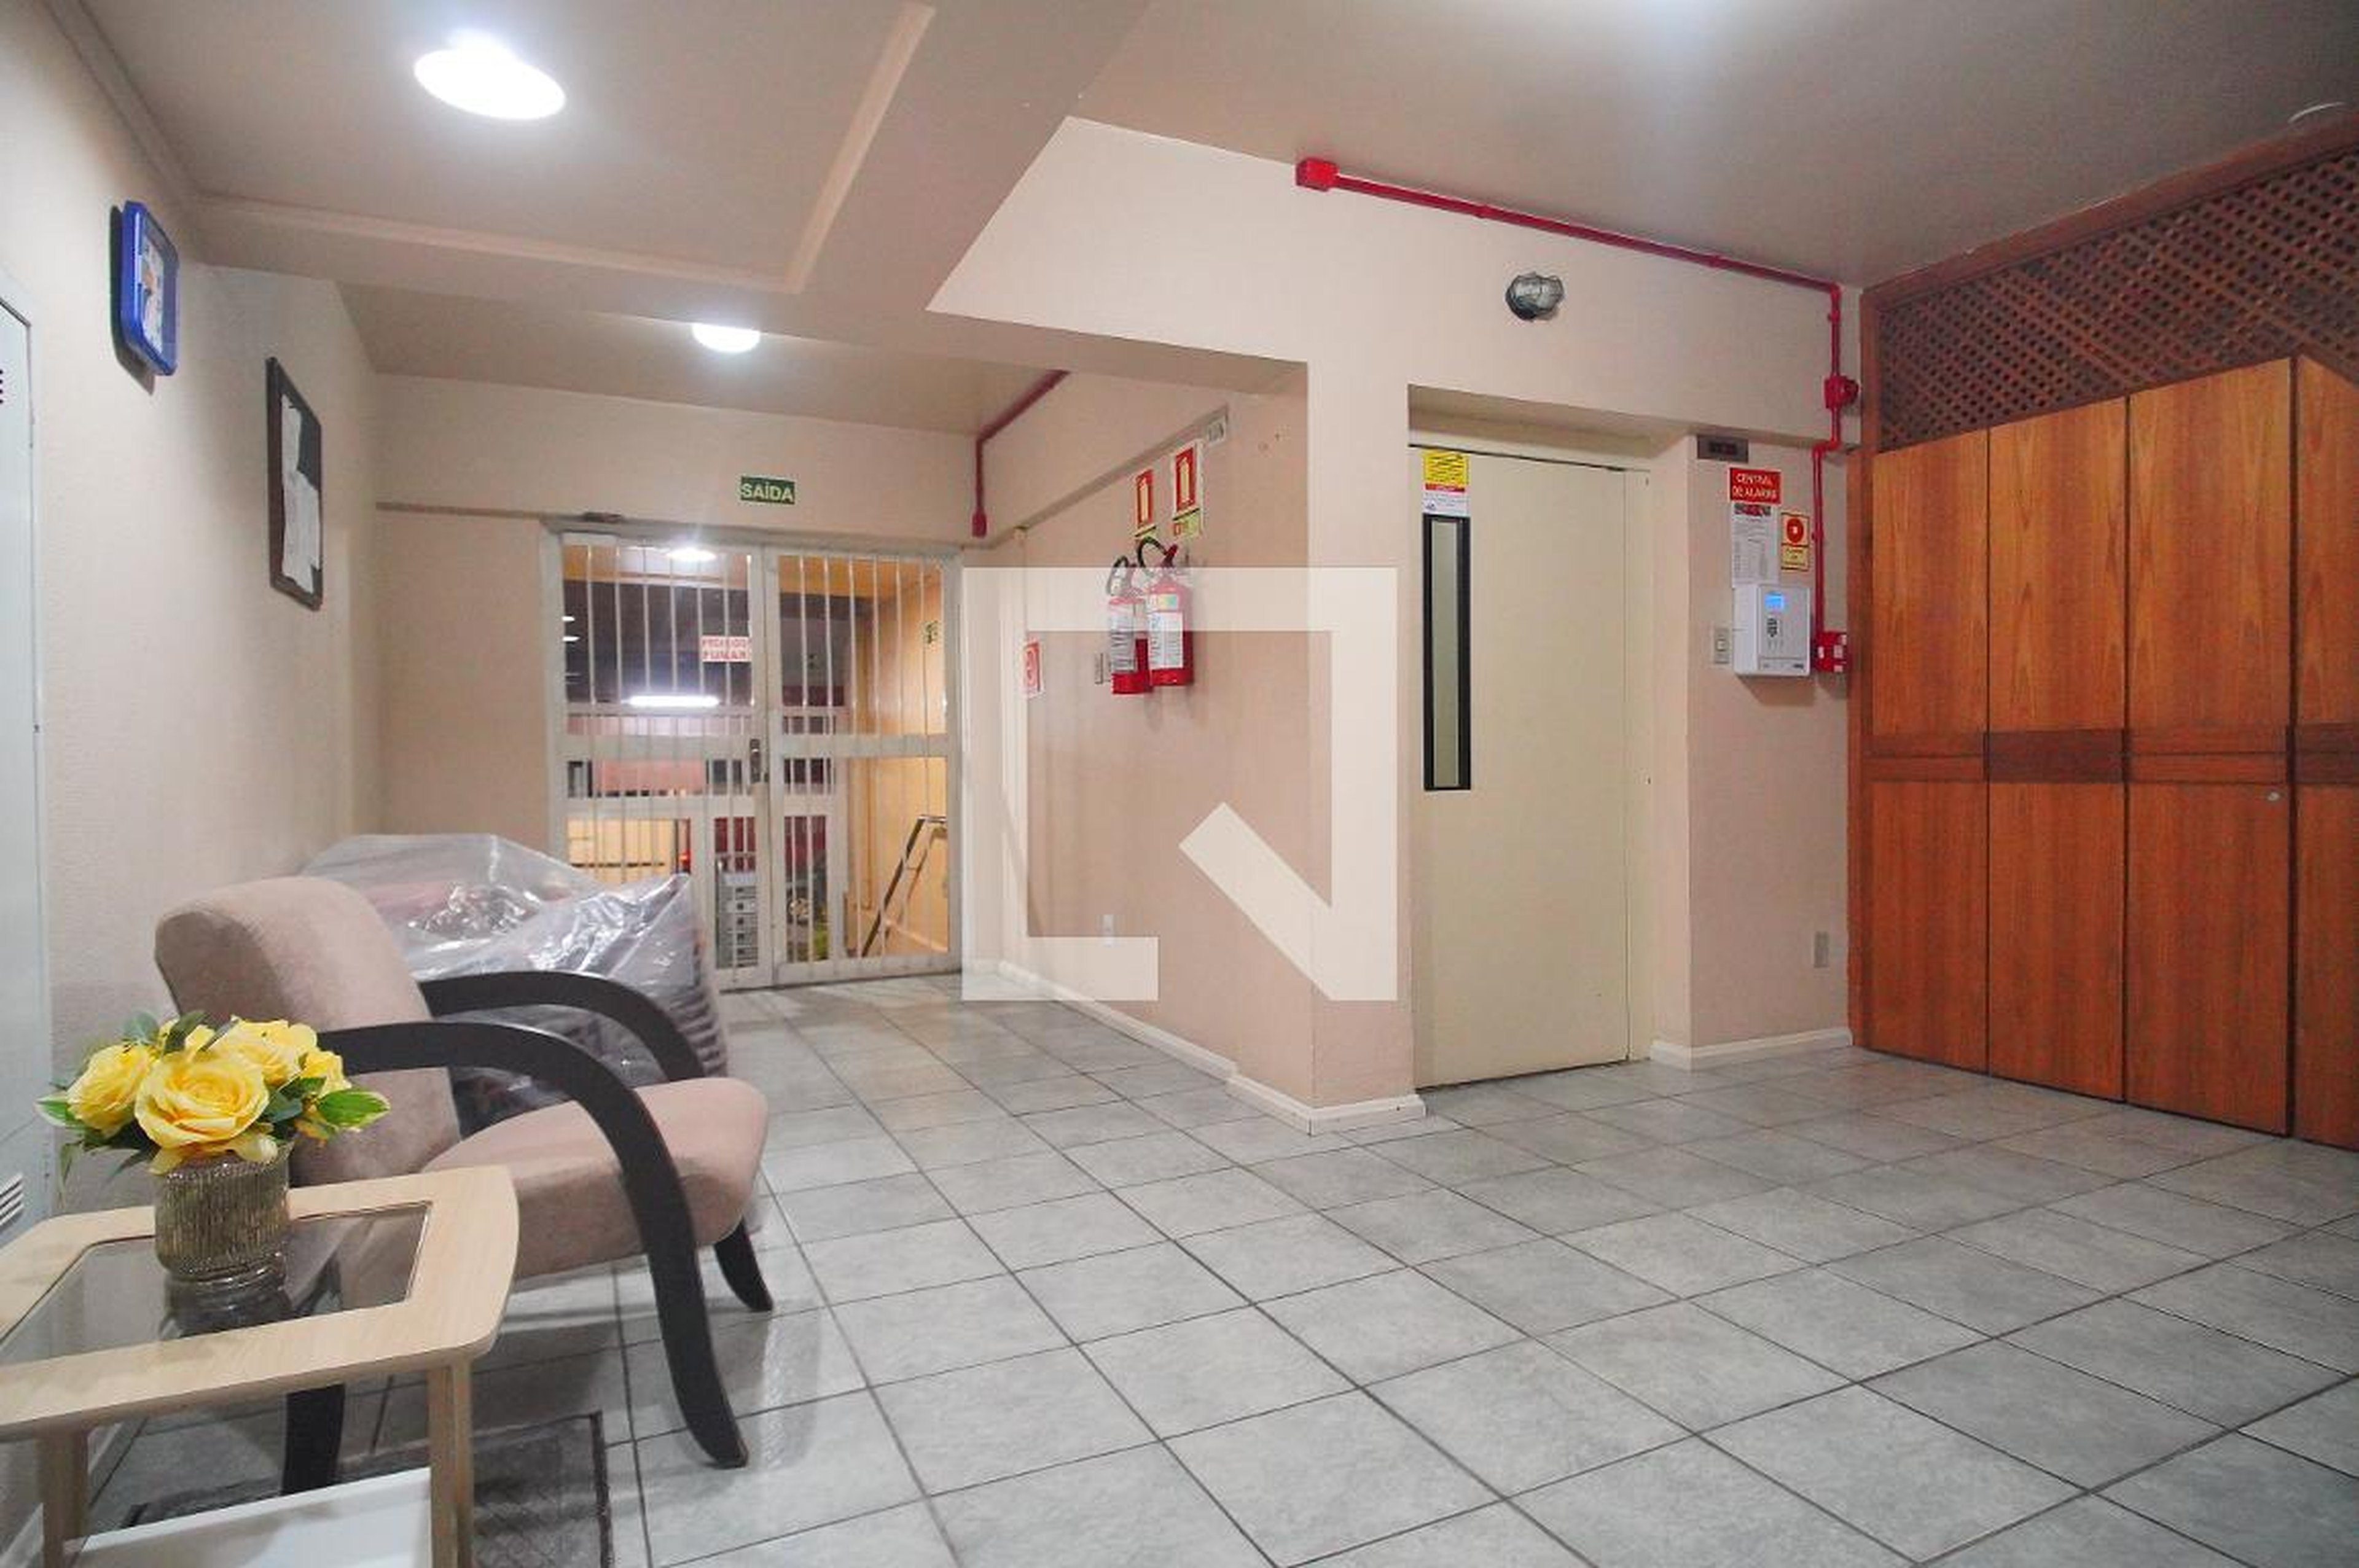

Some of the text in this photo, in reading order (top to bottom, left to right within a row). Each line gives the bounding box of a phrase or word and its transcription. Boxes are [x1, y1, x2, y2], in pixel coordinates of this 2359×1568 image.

[1735, 472, 1774, 486] CENTRAL
[741, 481, 794, 503] SAÍDA
[1732, 485, 1777, 500] DE ALARME
[703, 650, 747, 660] FUMAR
